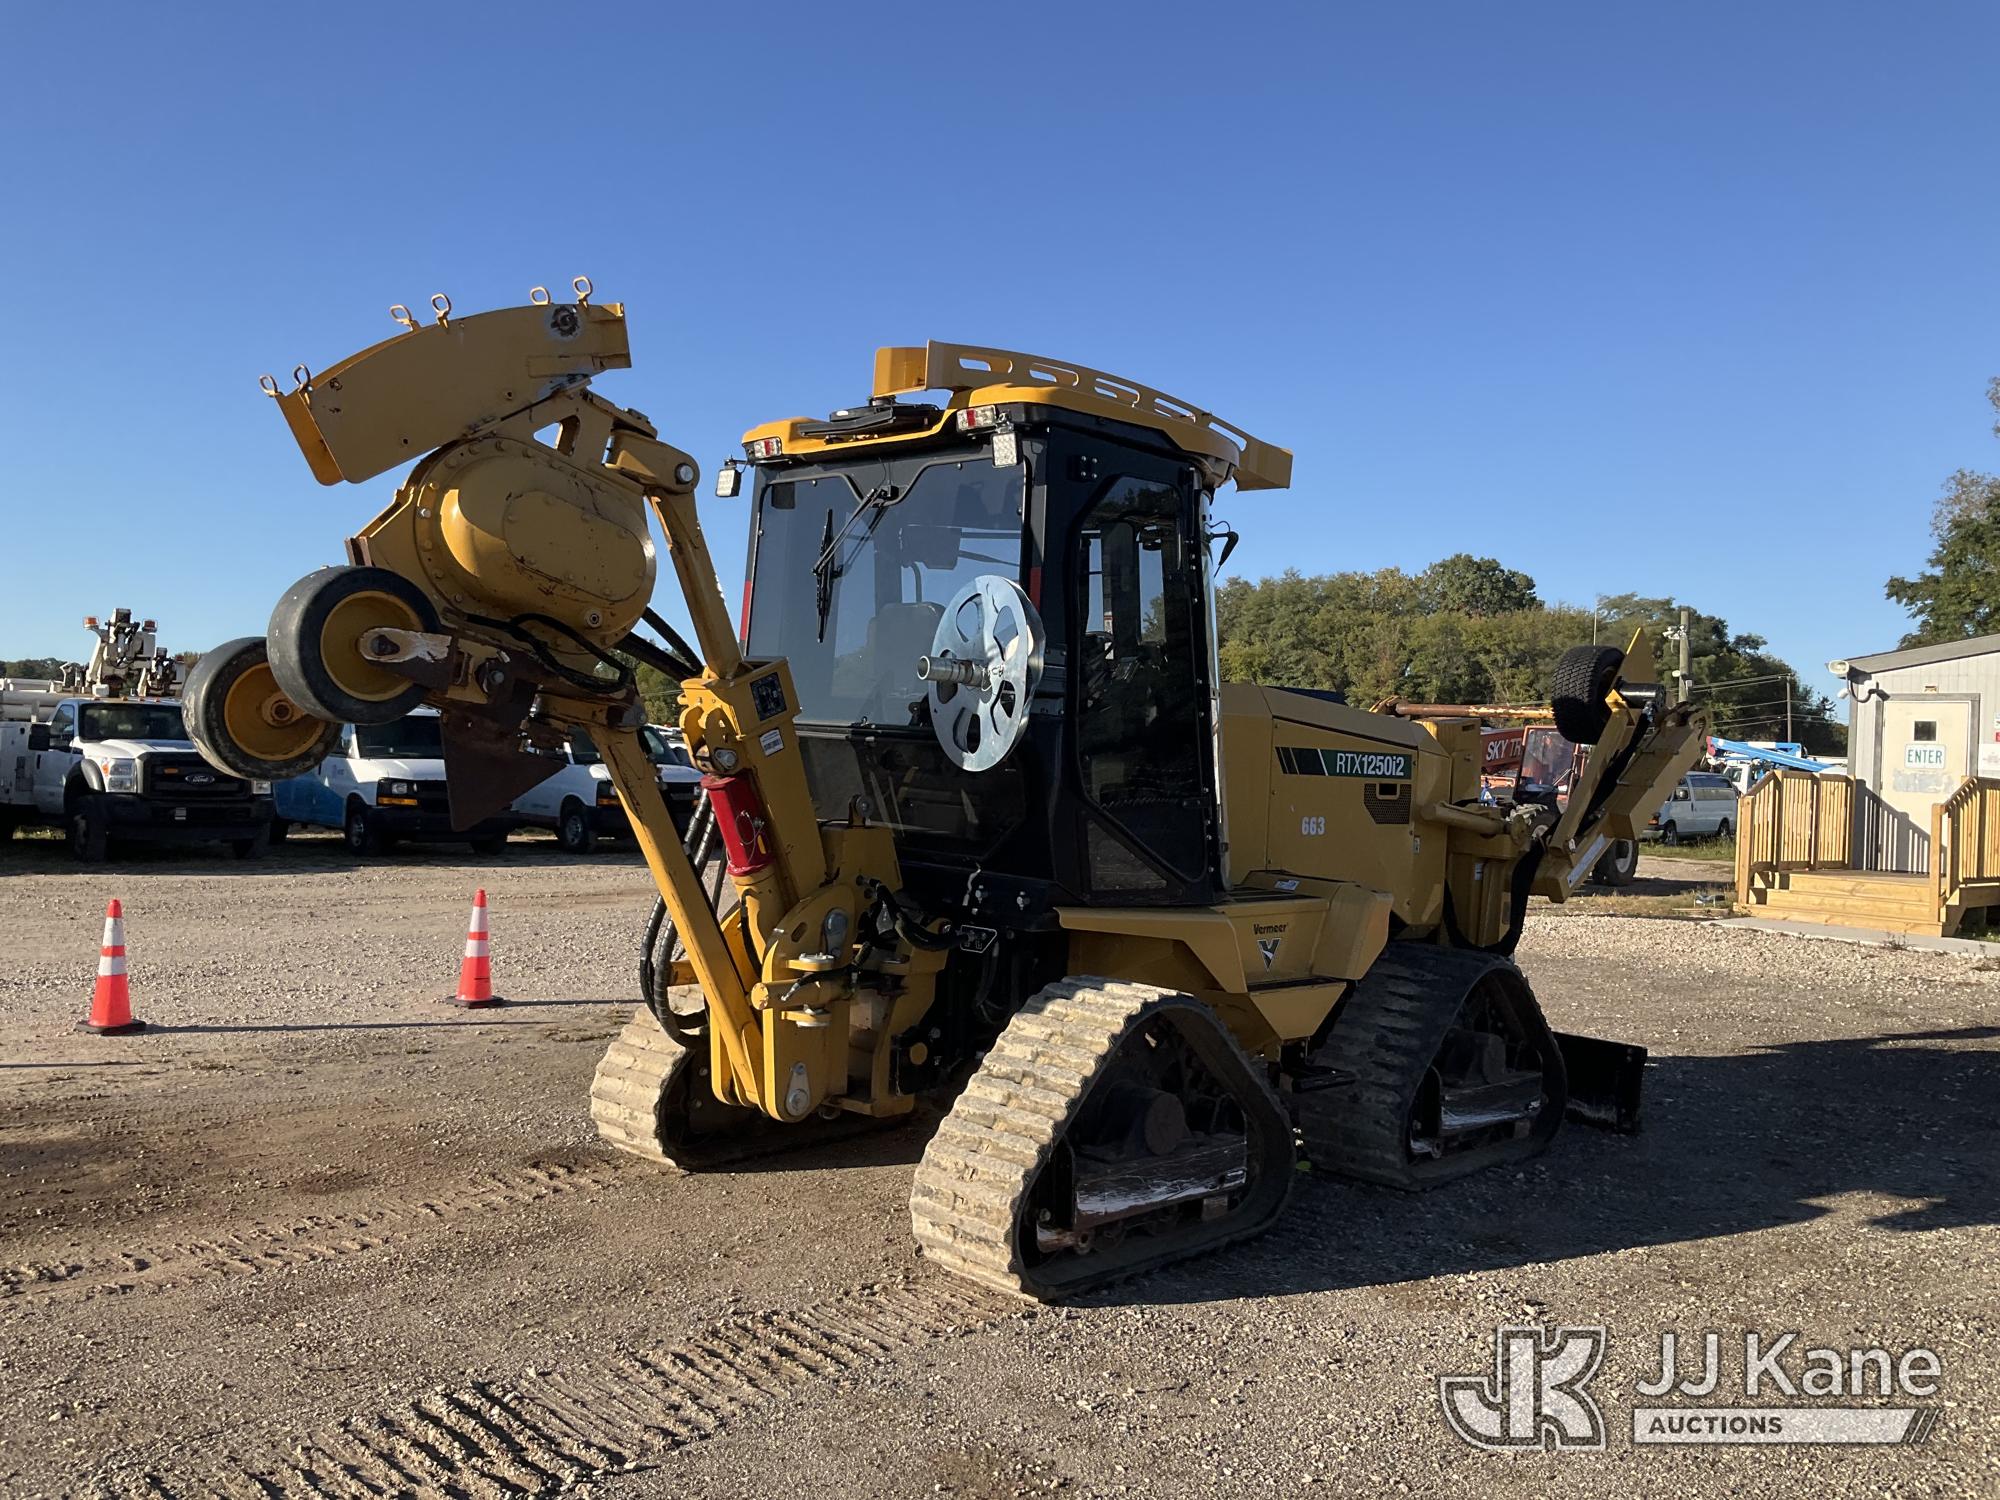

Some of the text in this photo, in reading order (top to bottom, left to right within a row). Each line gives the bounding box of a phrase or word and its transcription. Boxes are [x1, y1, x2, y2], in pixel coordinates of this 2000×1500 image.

[1486, 739, 1509, 761] SKY
[1907, 749, 1943, 764] ENTER
[1336, 752, 1405, 777] RTX1250i2
[1301, 816, 1326, 836] 663
[1253, 923, 1287, 935] Vermeer
